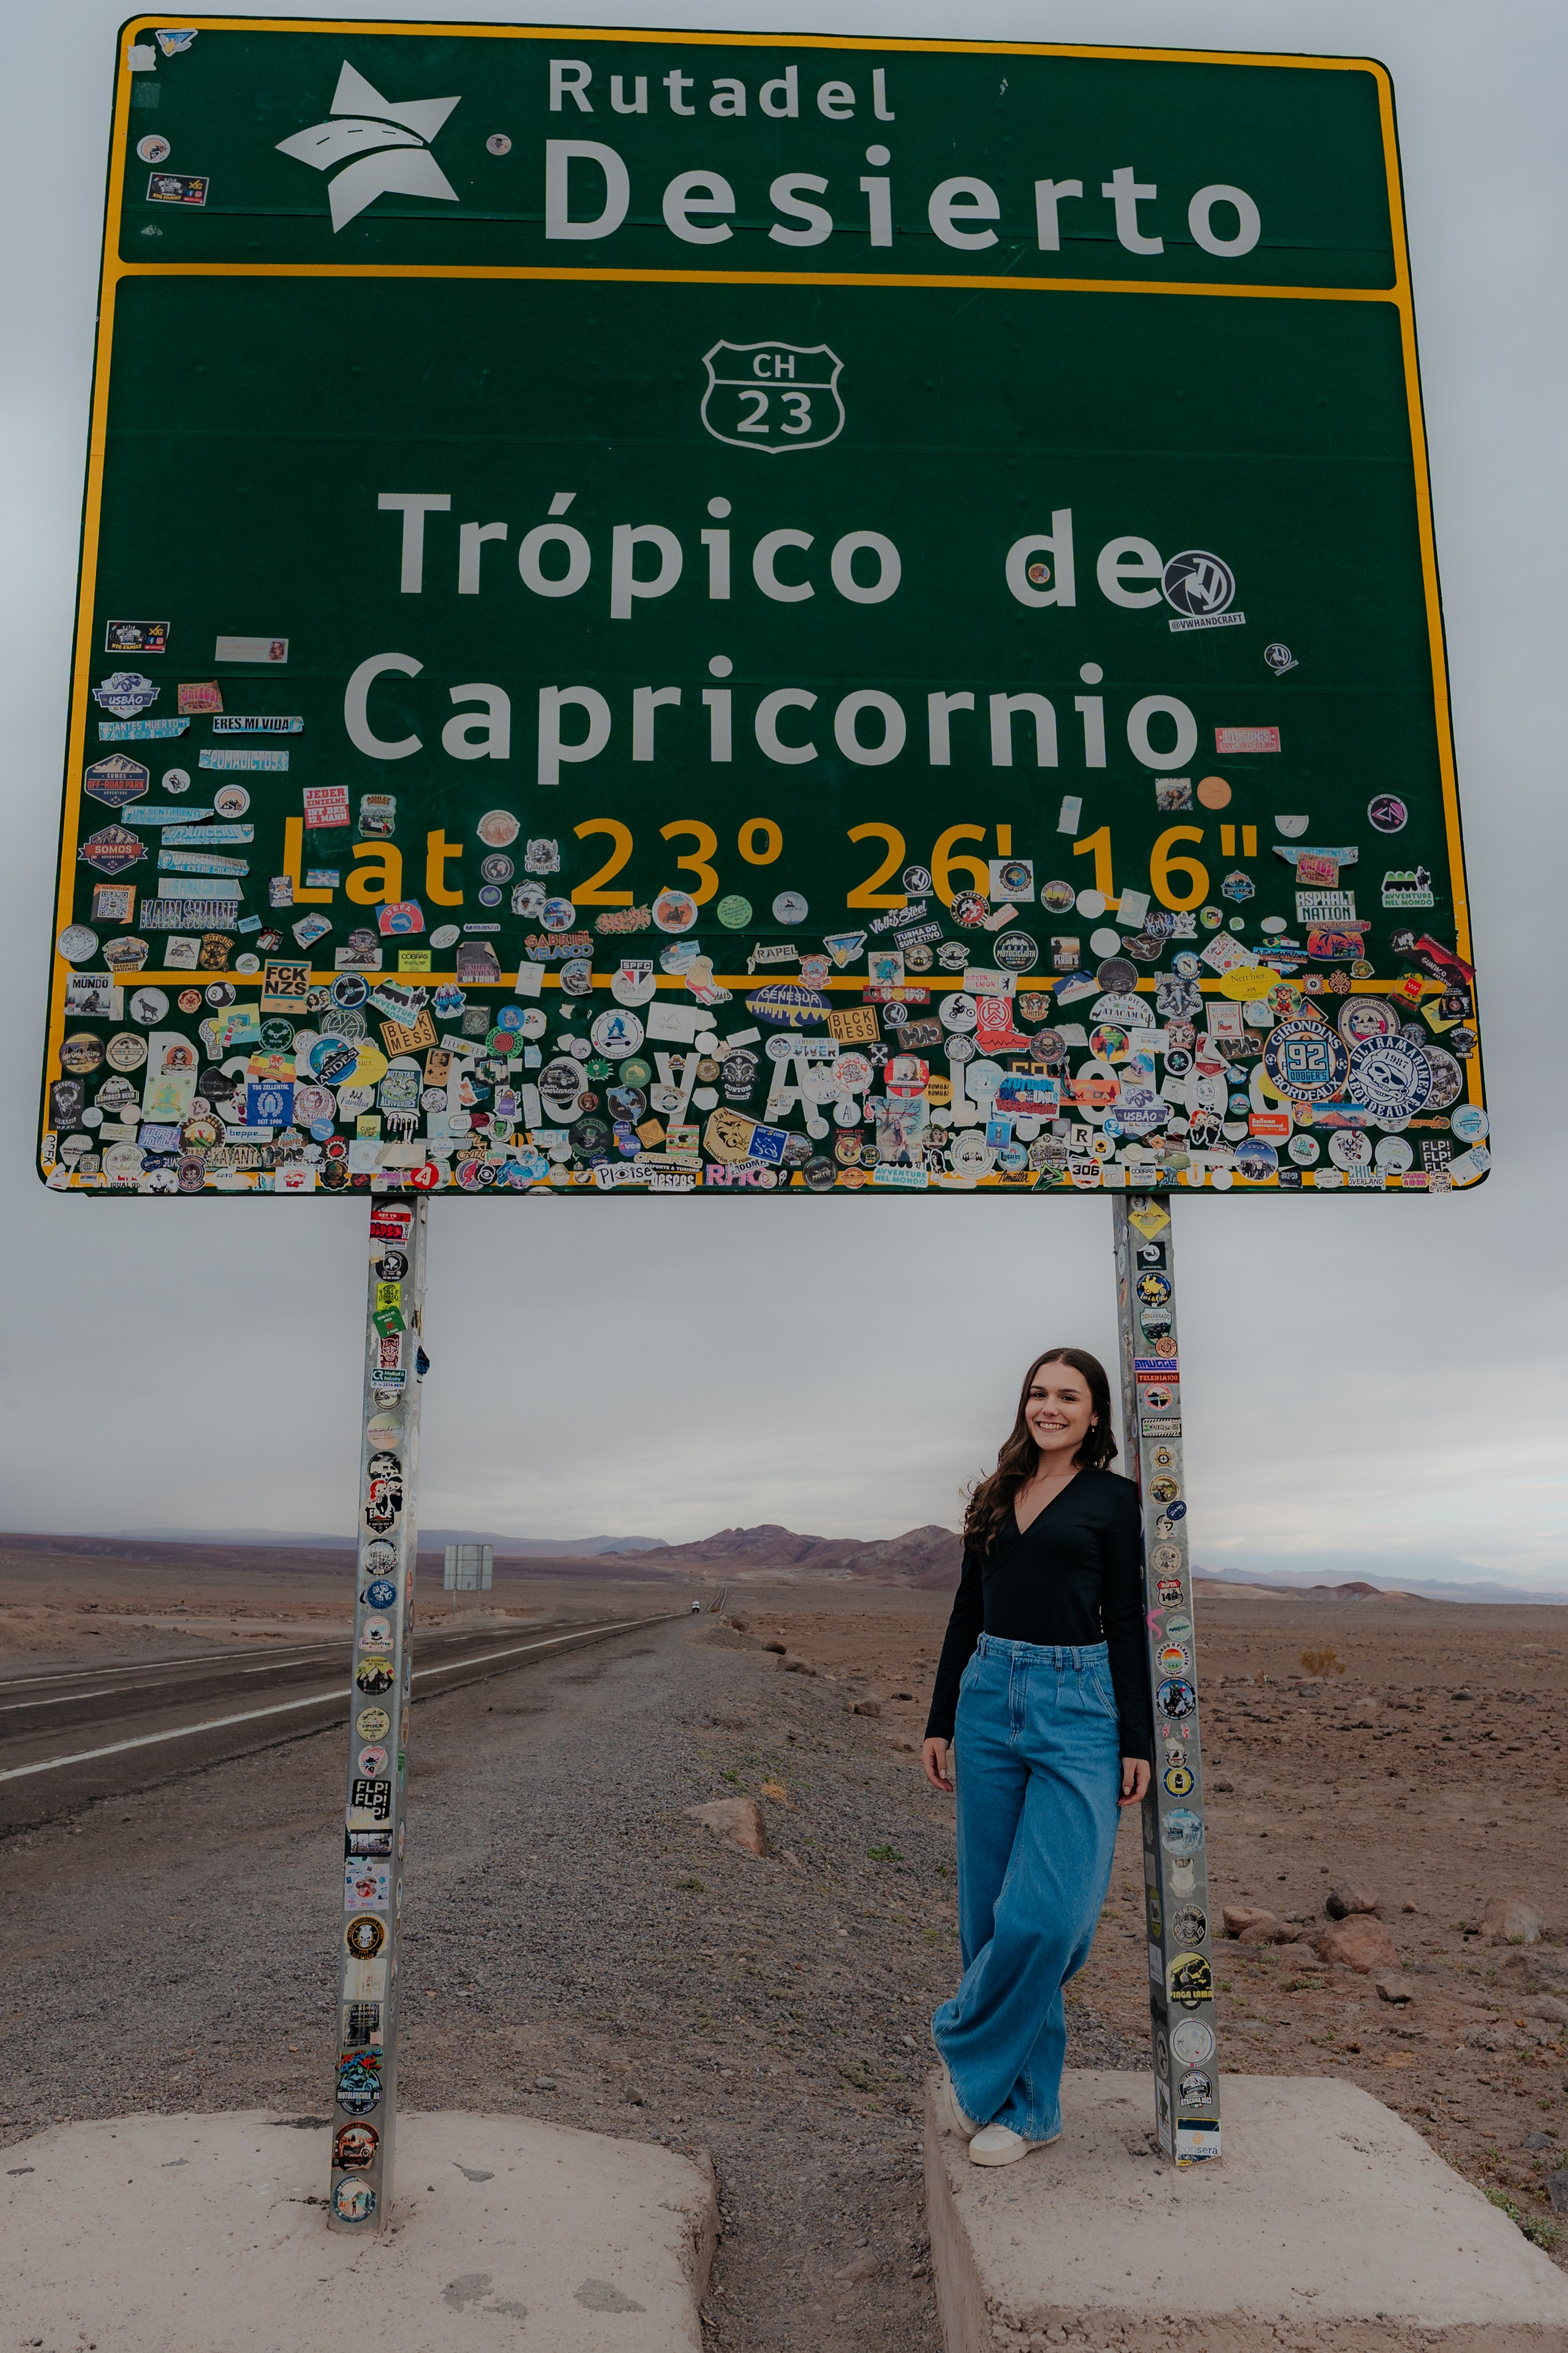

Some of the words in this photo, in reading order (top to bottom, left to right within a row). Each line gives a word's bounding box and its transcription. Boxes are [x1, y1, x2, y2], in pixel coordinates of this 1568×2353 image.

[546, 140, 1261, 257] Desierto
[753, 354, 794, 378] CH
[737, 390, 811, 434] 23
[378, 493, 901, 619] Trópico
[1006, 508, 1163, 608] de
[1172, 614, 1242, 630] @VWHANDCRAFT
[108, 693, 143, 704] USBÃO
[115, 722, 141, 731] ANTES
[145, 720, 178, 730] MUERTO
[215, 719, 241, 729] ERES
[245, 718, 258, 729] MI
[259, 719, 289, 730] VIDA
[345, 653, 1197, 785] Capricornio
[88, 780, 123, 788] OFF-ROAD
[307, 788, 344, 799] JEDER
[327, 806, 346, 815] DER
[309, 815, 320, 823] 12.
[322, 813, 347, 822] MANN
[284, 817, 463, 905] Lat
[571, 818, 782, 907] 23º
[1298, 891, 1354, 907] ASPHALT
[140, 899, 238, 929] KARLSRUHE
[386, 904, 412, 916] UEFA
[899, 899, 927, 922] Steel
[1303, 907, 1351, 921] NATION
[525, 931, 594, 948] GABRIEL
[897, 928, 924, 942] TURMA
[925, 924, 938, 934] DO
[899, 931, 941, 948] SUPLETIVO
[203, 935, 233, 948] SATIROS
[525, 944, 594, 961] VELASCO
[997, 950, 1035, 958] MOTOCICLISTA
[1182, 960, 1193, 970] N
[1421, 957, 1447, 977] GUANACO
[265, 967, 307, 981] FCK
[1178, 970, 1200, 980] AUSTRALIA
[1232, 973, 1248, 983] Nett
[1250, 971, 1267, 980] hier.
[72, 979, 108, 989] MUNDO
[264, 980, 306, 995] NZS
[1063, 984, 1088, 995] INTOCHILE
[761, 989, 818, 1003] GENESUR
[370, 995, 417, 1022] AVVENTURE
[1347, 1000, 1372, 1013] VIAJEROS
[1372, 1001, 1390, 1014] LIBRES
[383, 1008, 415, 1027] MONDO
[833, 1011, 872, 1027] BLCK
[1102, 1009, 1144, 1019] ATACAMA
[834, 1025, 874, 1040] MESS
[1270, 1019, 1343, 1051] GIRONDINS
[391, 1029, 432, 1051] MESS
[1287, 1043, 1327, 1071] 92
[1383, 1050, 1409, 1069] 1987
[319, 1049, 358, 1084] ANDES
[1351, 1036, 1428, 1097] ULTRAMARINES
[1290, 1071, 1328, 1082] DODGER'S
[724, 1084, 752, 1093] CUSTOM
[1272, 1075, 1343, 1101] BORDEAUX
[122, 1091, 135, 1100] BEER
[1350, 1075, 1417, 1119] BORDEAUX
[380, 1097, 417, 1108] ALVIVERDES
[1123, 1111, 1158, 1121] USBÃO
[144, 1127, 178, 1139] WORST
[230, 1129, 258, 1138] beppe
[1076, 1130, 1088, 1143] R
[143, 1136, 176, 1147] ADVICE
[1422, 1141, 1450, 1150] FLP!
[635, 1152, 703, 1168] CRISROD
[1001, 1151, 1021, 1162] Lugares
[1422, 1152, 1451, 1161] FLP!
[876, 1168, 927, 1179] AVVENTURE
[1072, 1165, 1100, 1176] 306
[1348, 1165, 1383, 1178] CHILE
[892, 1176, 926, 1185] MONDO
[356, 1781, 389, 1794] FLP!
[355, 1793, 387, 1805] FLP!
[1193, 1989, 1213, 1999] LAMA
